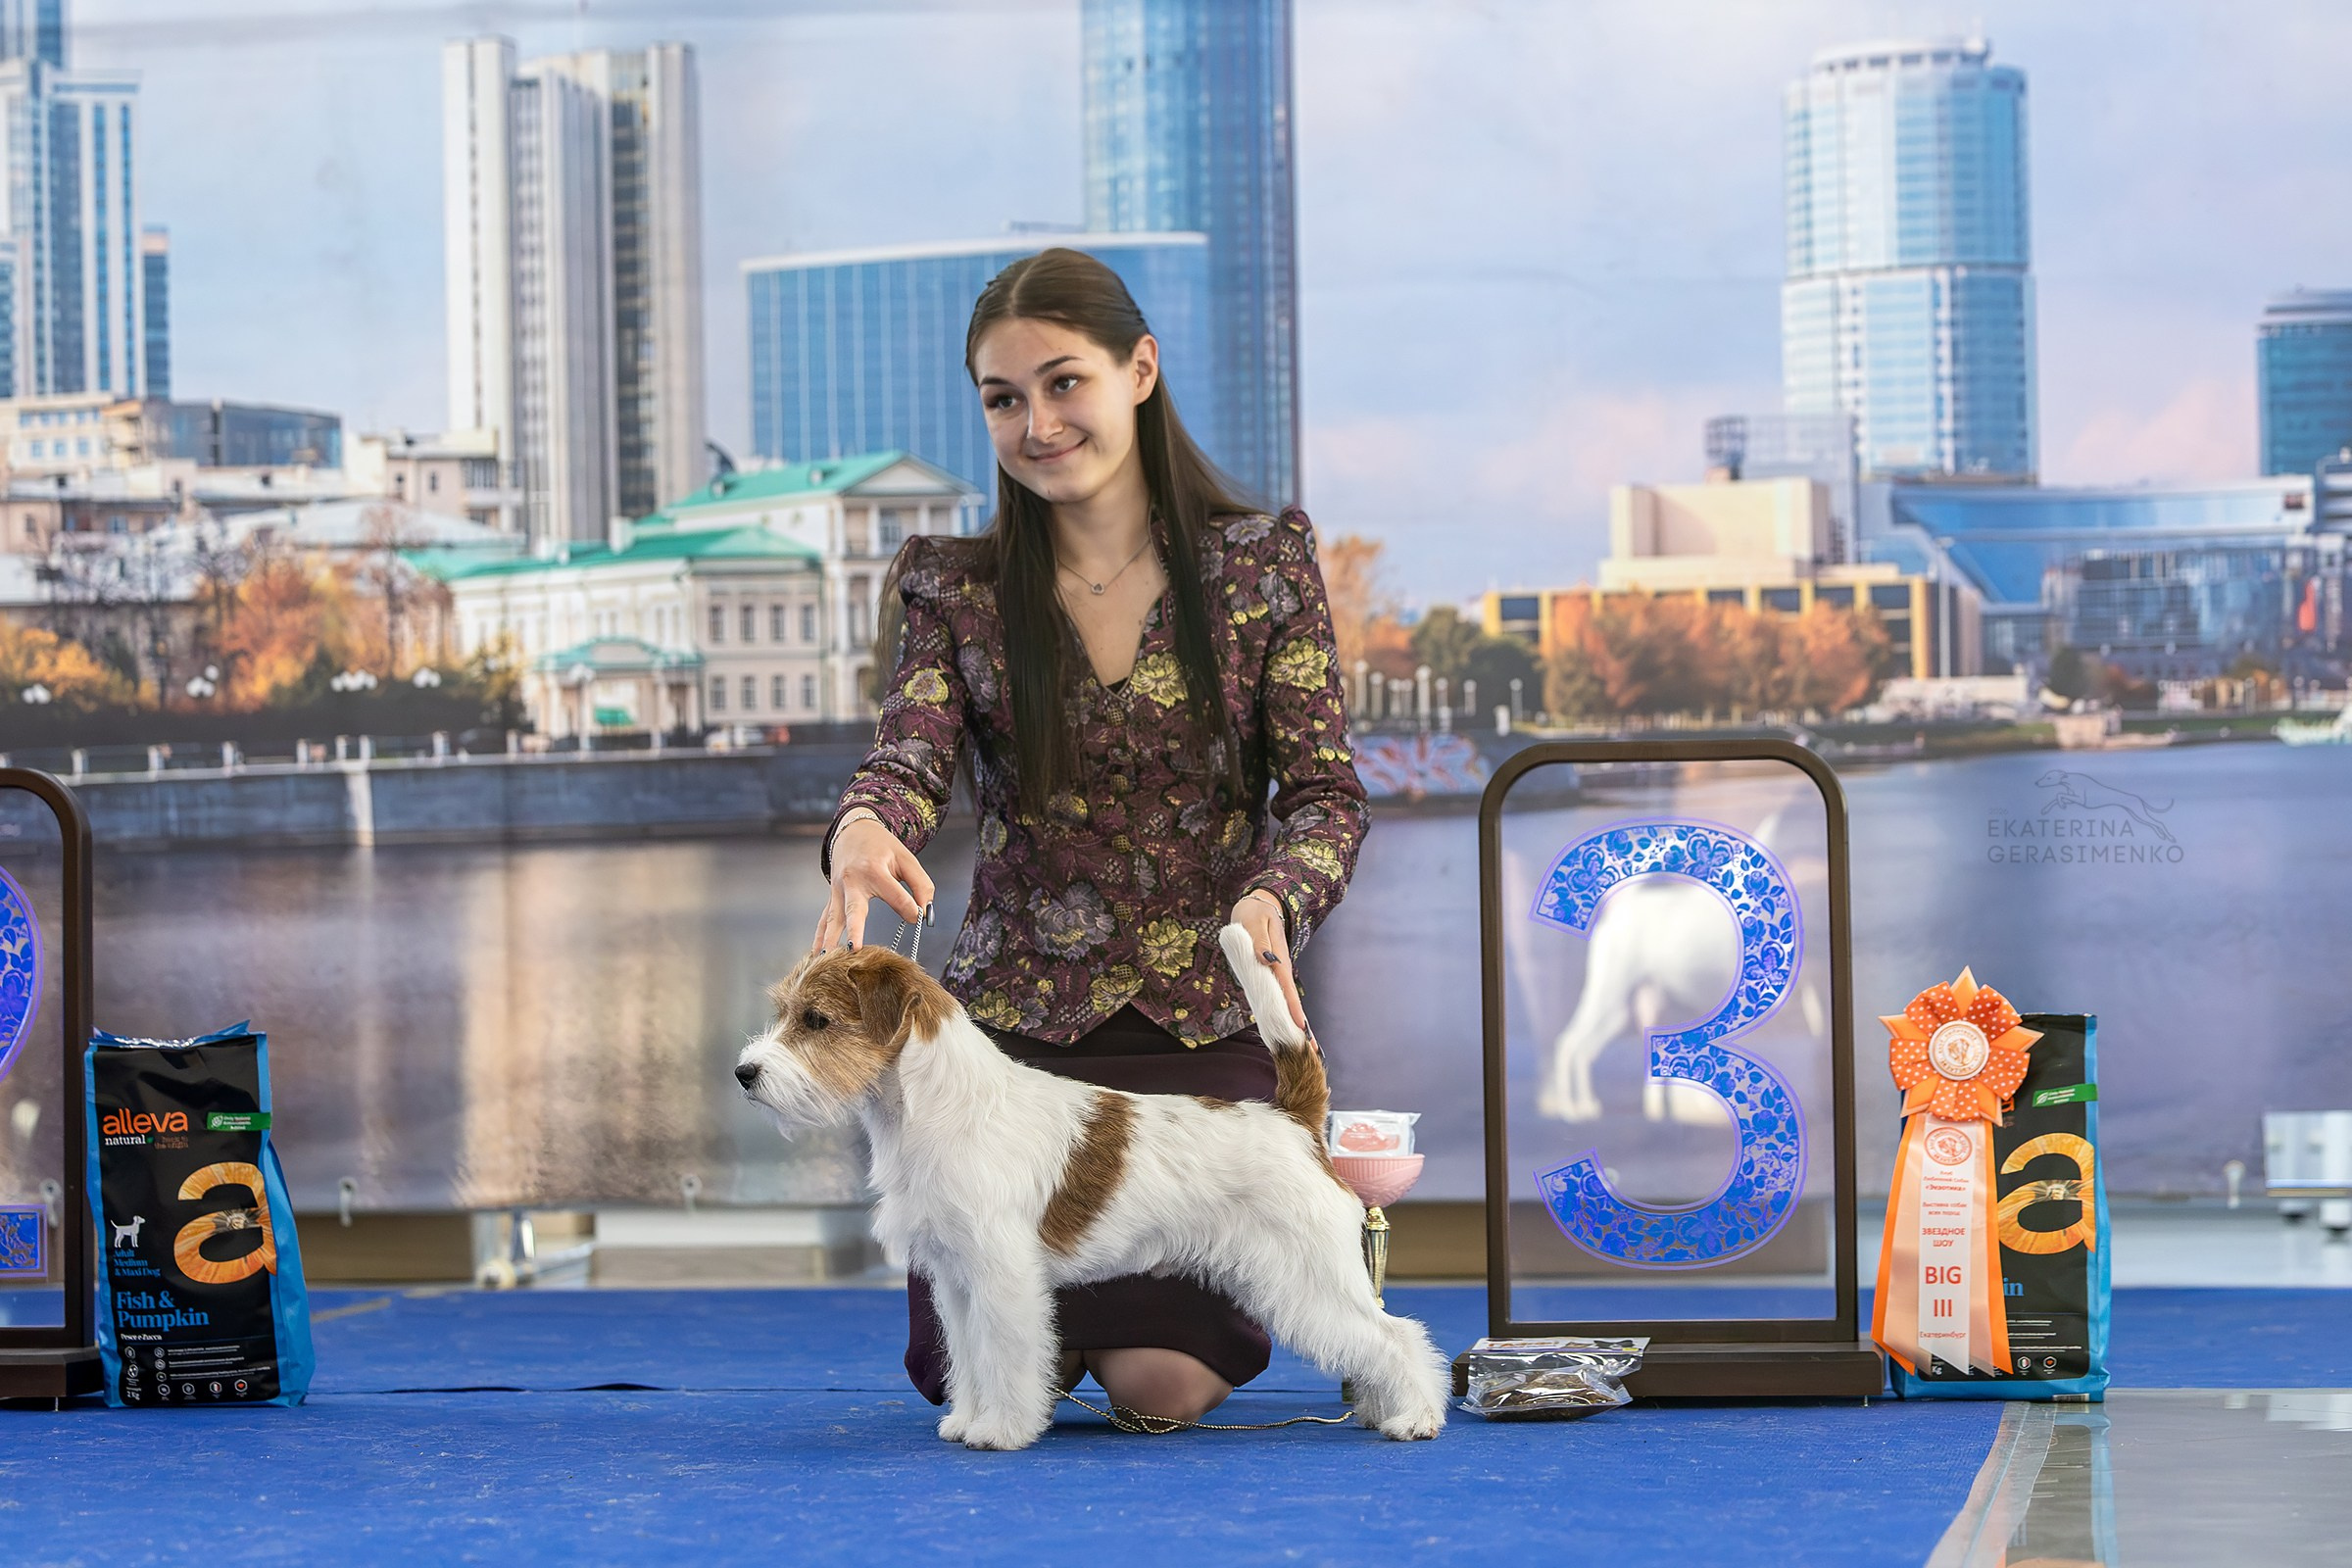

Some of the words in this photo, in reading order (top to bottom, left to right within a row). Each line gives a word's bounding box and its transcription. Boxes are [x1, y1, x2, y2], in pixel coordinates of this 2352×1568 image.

[1530, 817, 1806, 1269] 3
[103, 1107, 188, 1135] alleva
[105, 1134, 146, 1146] natural
[1922, 1227, 1966, 1236] ЗВЕЗДНОЕ
[1925, 1265, 1962, 1284] BIG
[117, 1291, 156, 1309] Fish
[159, 1290, 175, 1308] &
[1934, 1298, 1953, 1317] III
[118, 1307, 210, 1332] Pumpkin
